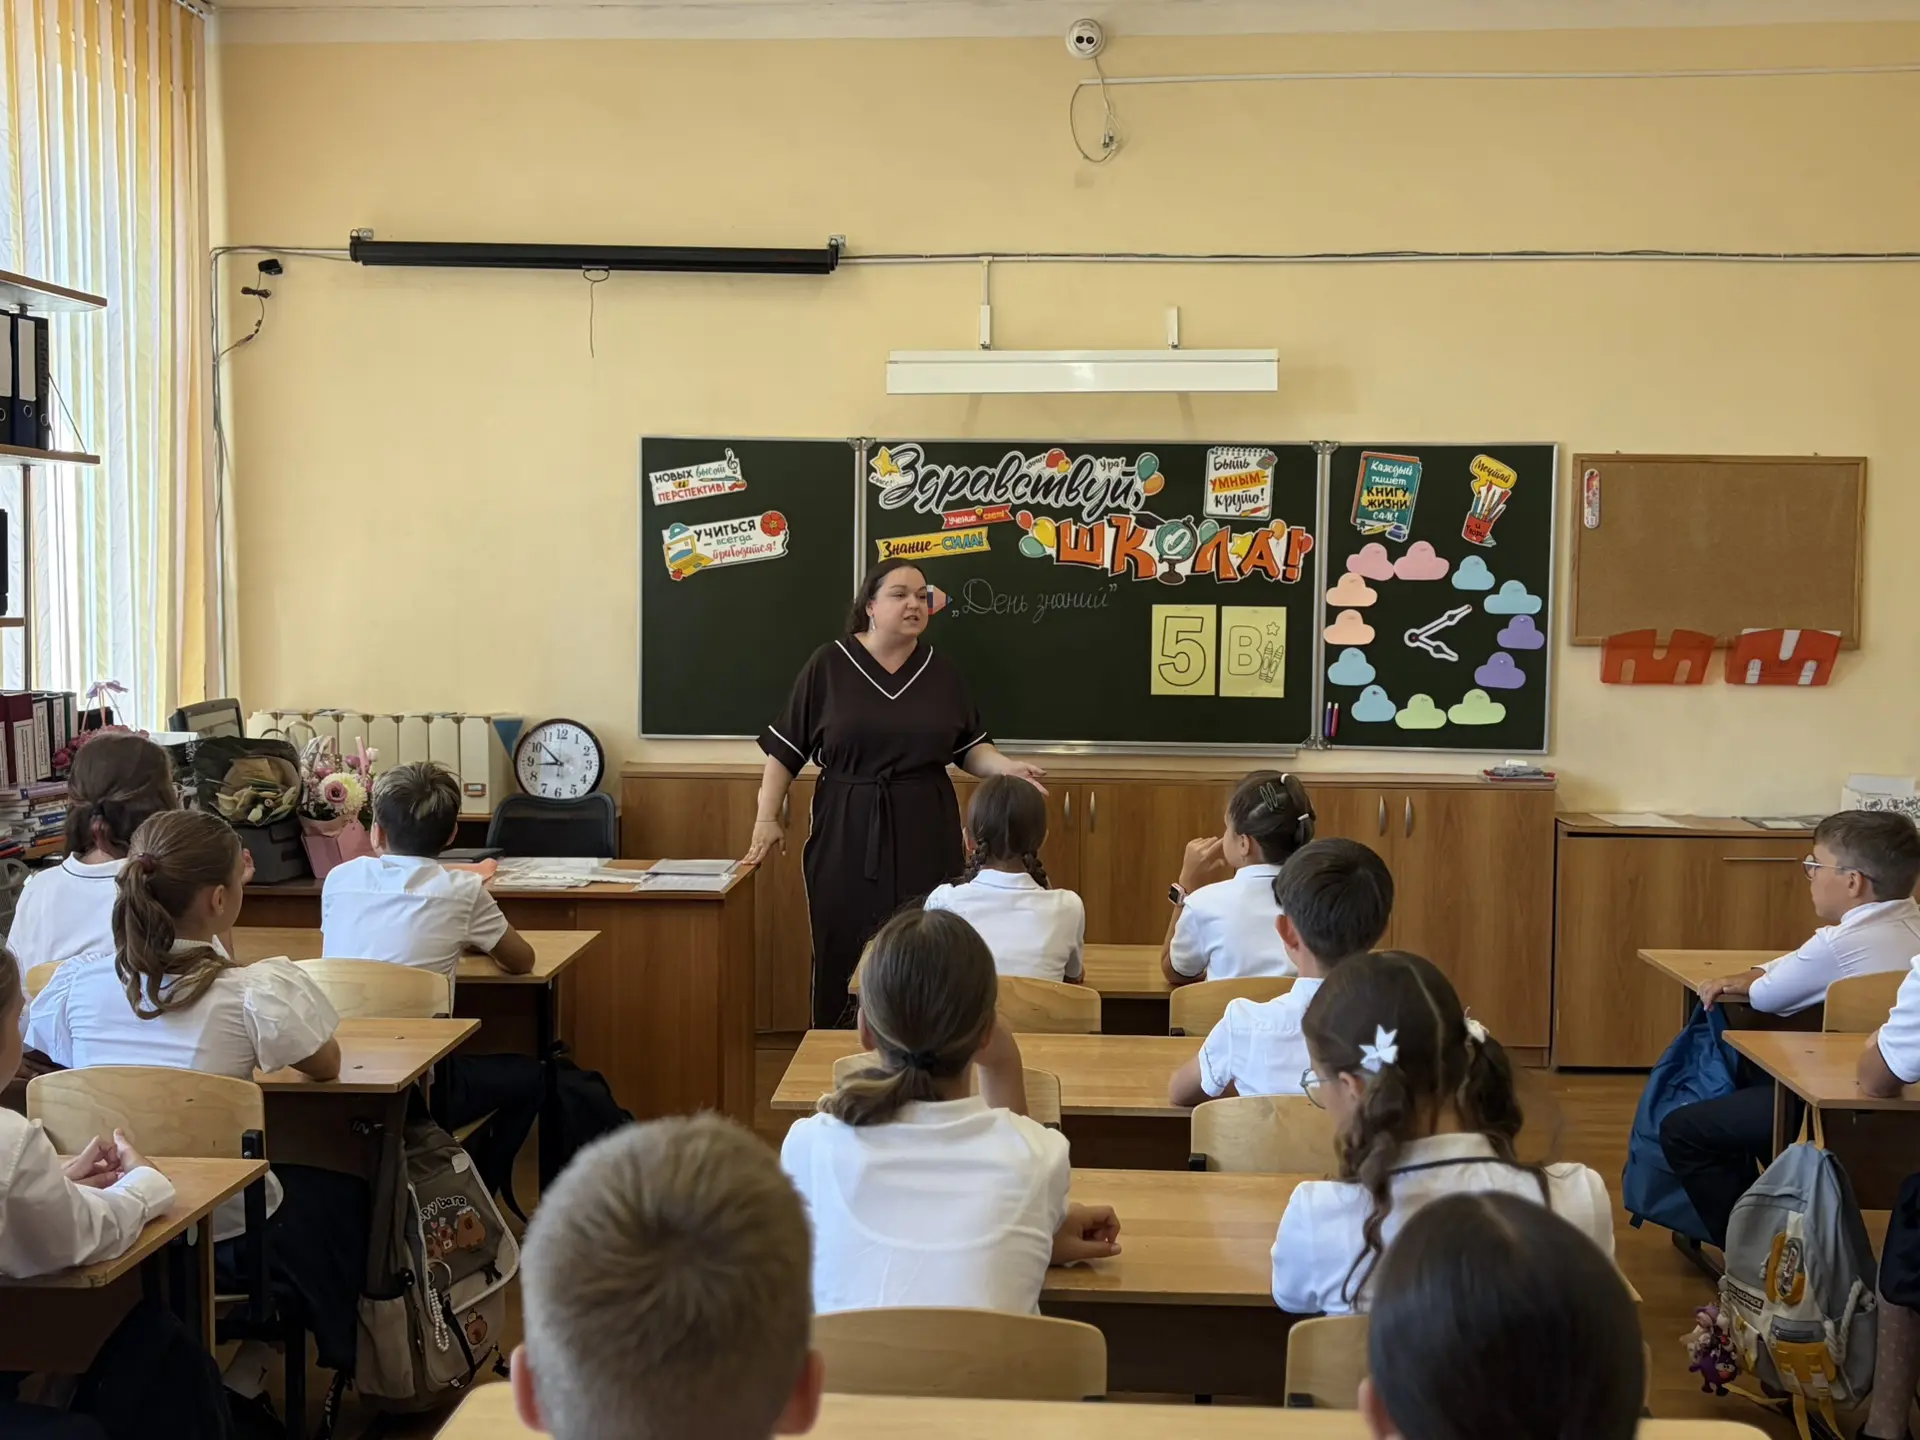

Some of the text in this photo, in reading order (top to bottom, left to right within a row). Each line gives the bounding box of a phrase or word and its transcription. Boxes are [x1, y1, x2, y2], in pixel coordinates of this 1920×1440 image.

[1100, 457, 1124, 473] Ура!
[1214, 455, 1250, 471] Быть
[1370, 460, 1412, 477] Каждый
[654, 469, 693, 483] НОВЫХ
[1474, 459, 1511, 484] Мечтай
[882, 446, 1142, 520] Здравствуй,
[1371, 475, 1406, 486] пишет
[658, 482, 726, 502] ПЕРСПЕКТИВ!
[1366, 486, 1409, 498] КНИГУ
[1214, 488, 1265, 513] круто!
[1366, 498, 1408, 509] ЖИЗНИ
[1372, 511, 1399, 522] сам!
[693, 519, 756, 542] УЧИТЬСЯ
[716, 534, 753, 545] всегда
[713, 540, 777, 563] пригодится!
[1056, 514, 1304, 583] ШКОЛА!
[543, 731, 553, 742] 11
[556, 728, 569, 740] 12
[532, 742, 542, 753] 10
[583, 746, 590, 756] 2
[527, 756, 535, 767] 9
[585, 760, 593, 771] 3
[530, 771, 538, 782] 8
[580, 774, 587, 784] 4
[540, 783, 548, 794] 7
[554, 787, 562, 798] 6
[569, 784, 577, 795] 5
